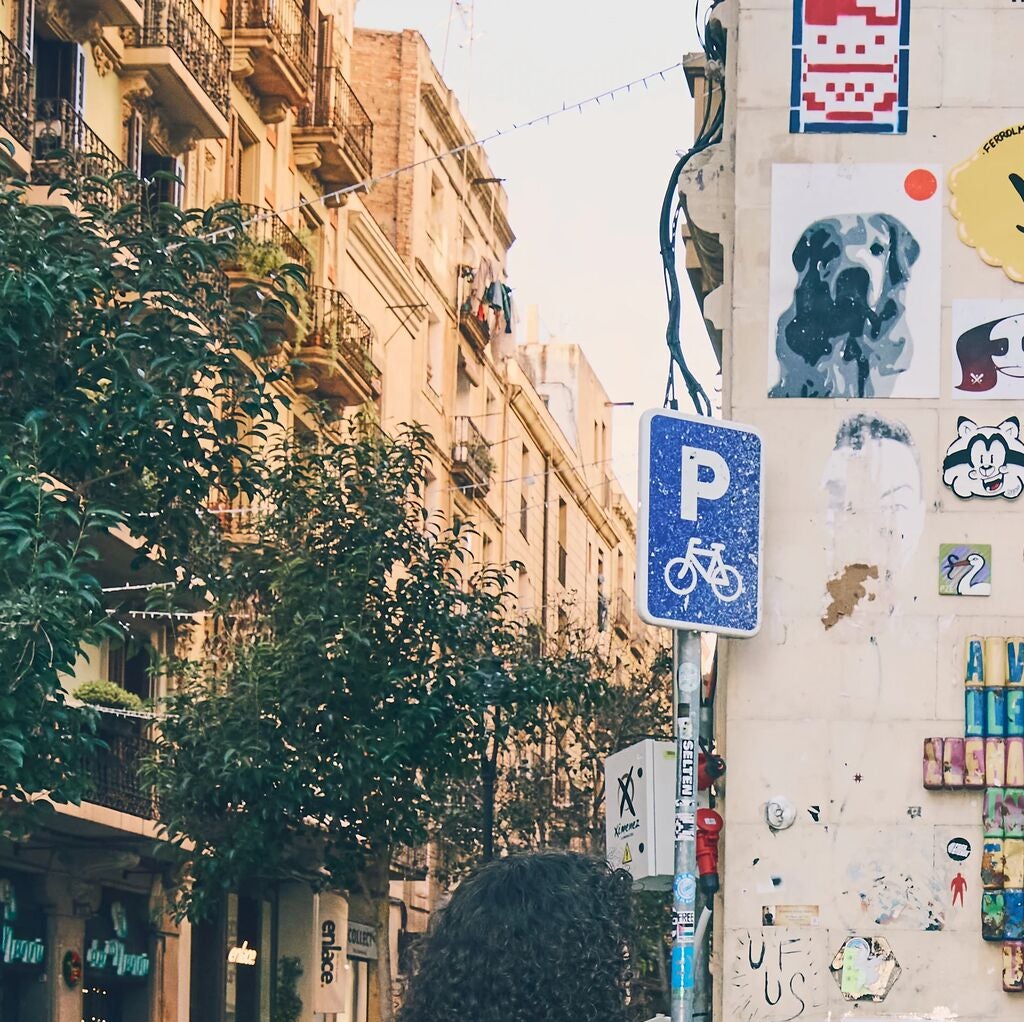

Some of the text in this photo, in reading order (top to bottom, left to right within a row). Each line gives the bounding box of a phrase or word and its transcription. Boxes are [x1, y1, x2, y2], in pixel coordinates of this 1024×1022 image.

[680, 445, 731, 521] P
[966, 640, 984, 683] A
[682, 740, 694, 796] SELTEN
[678, 912, 694, 922] FREE
